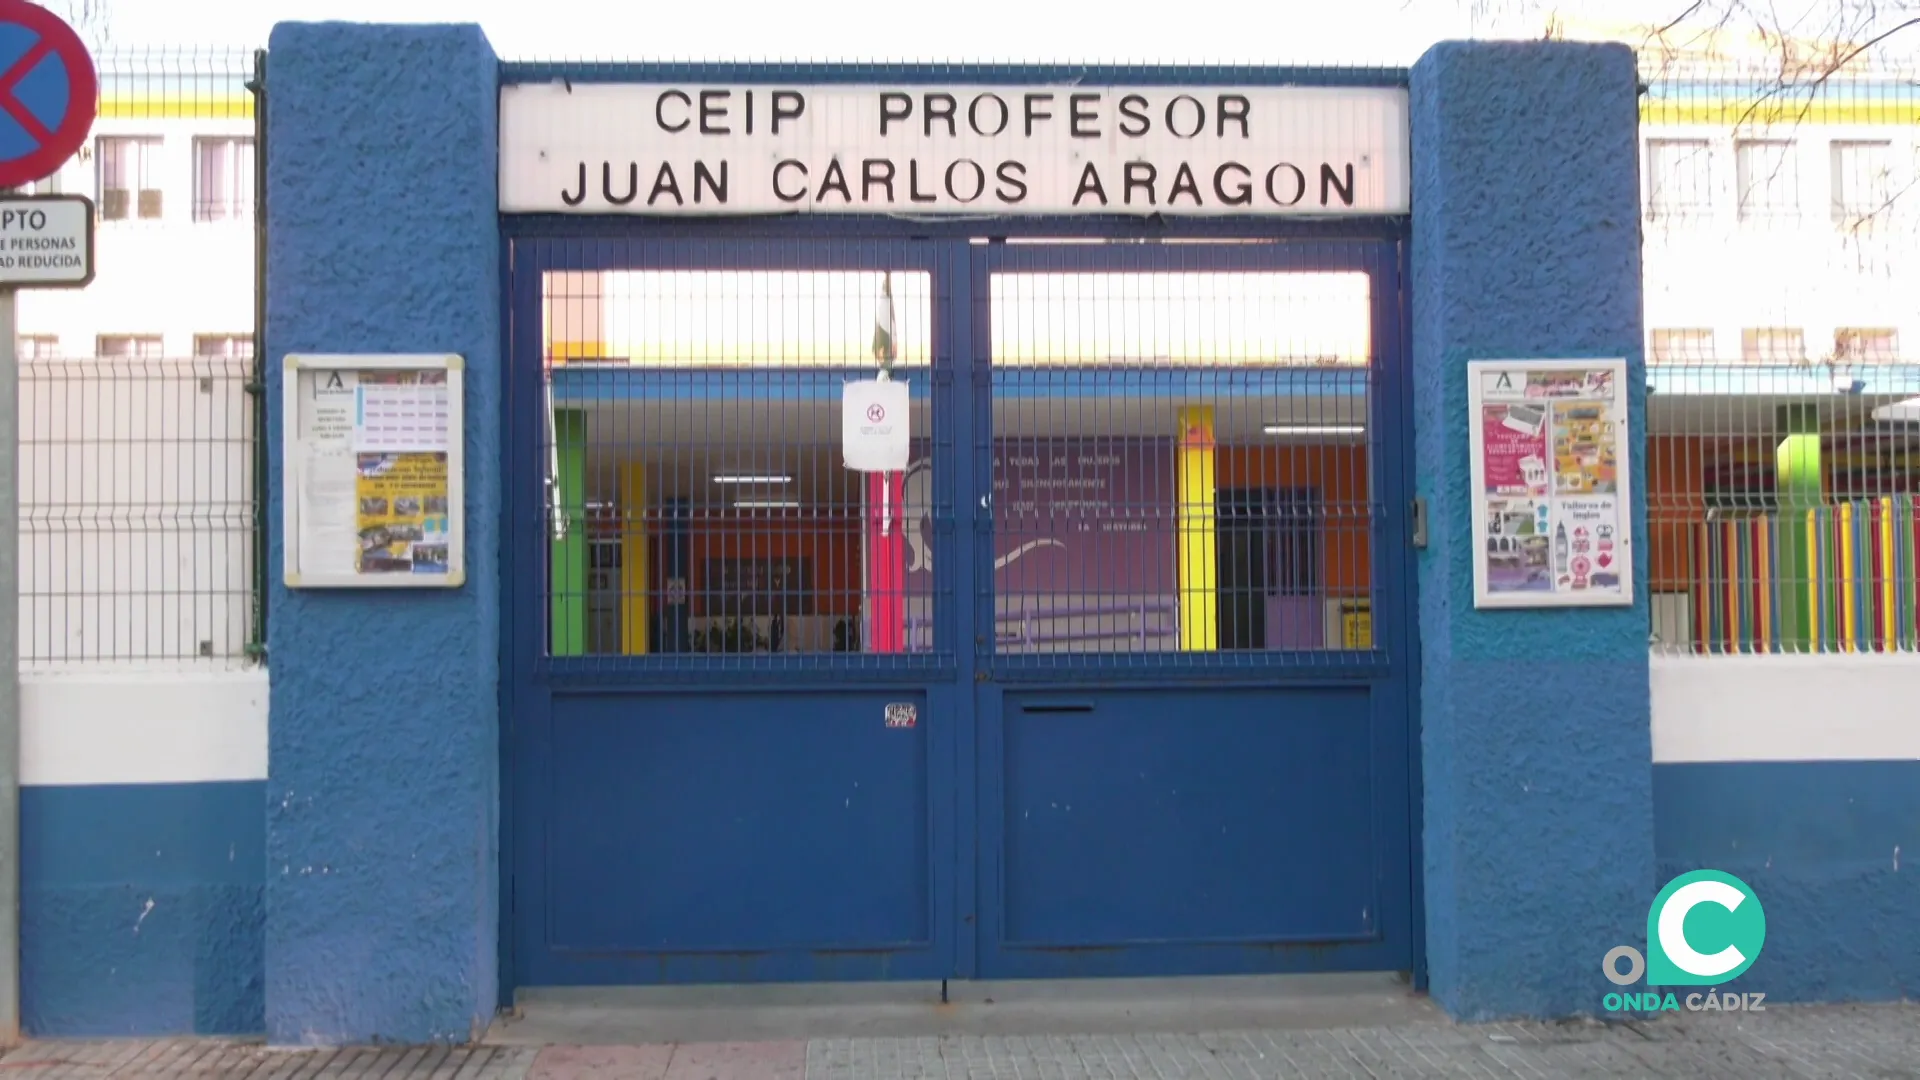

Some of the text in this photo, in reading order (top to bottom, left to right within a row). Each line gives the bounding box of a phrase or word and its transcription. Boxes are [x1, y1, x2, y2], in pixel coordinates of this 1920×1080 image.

[656, 89, 1251, 139] CEIP PROFESOR
[561, 157, 1354, 206] JUAN CARLOS ARAGON
[2, 209, 46, 230] PTO
[11, 236, 76, 251] PERSONAS
[18, 254, 81, 268] REDUCIDA
